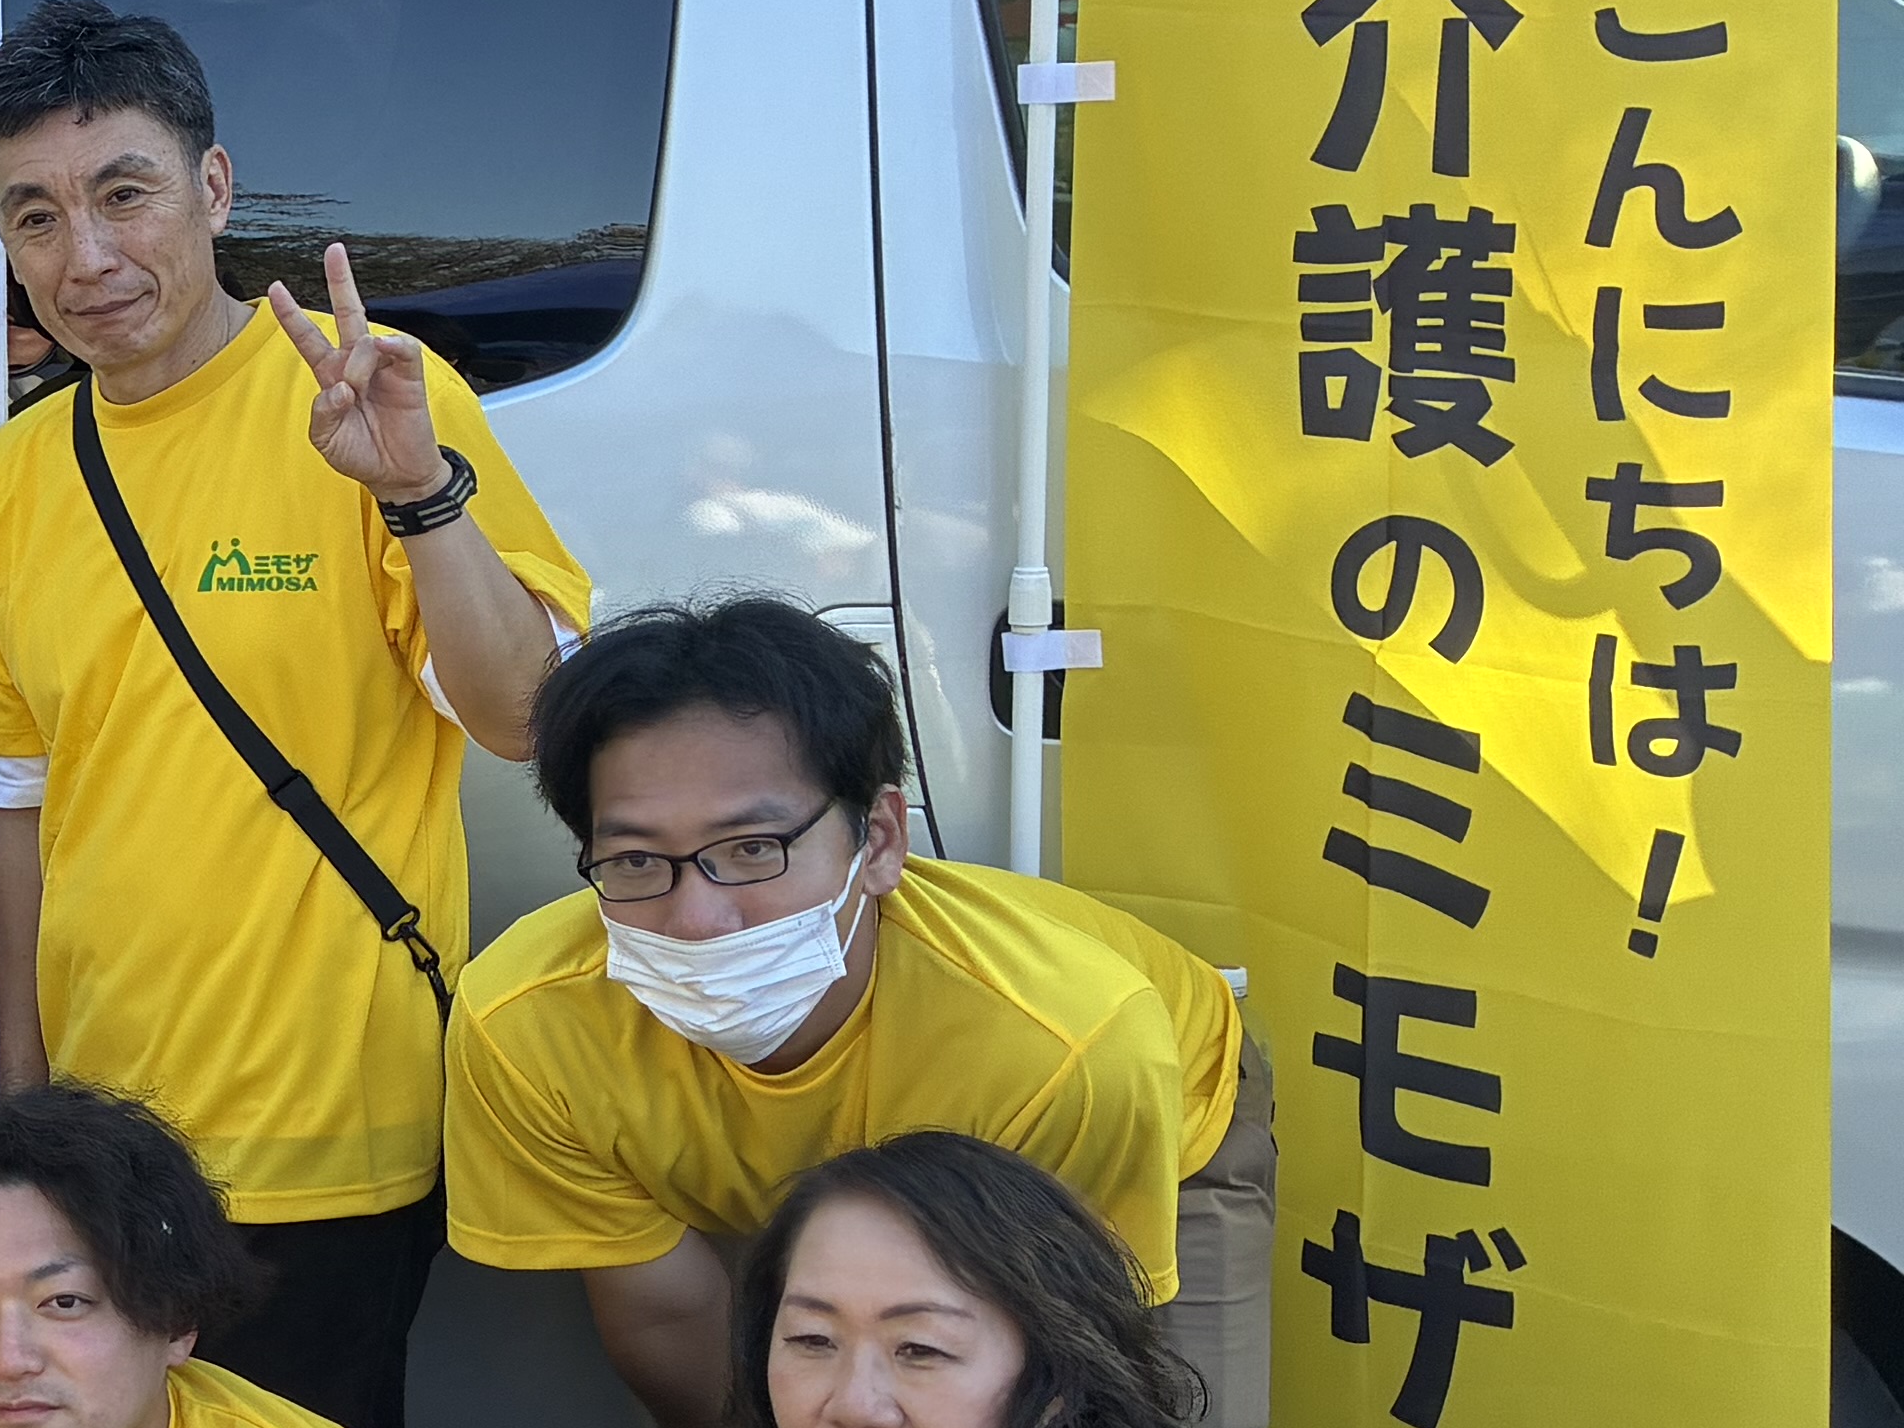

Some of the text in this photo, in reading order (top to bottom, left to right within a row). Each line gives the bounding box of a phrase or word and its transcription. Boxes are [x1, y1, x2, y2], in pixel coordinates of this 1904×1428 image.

[253, 553, 319, 574] ミモザ
[216, 576, 318, 592] MIMOSA
